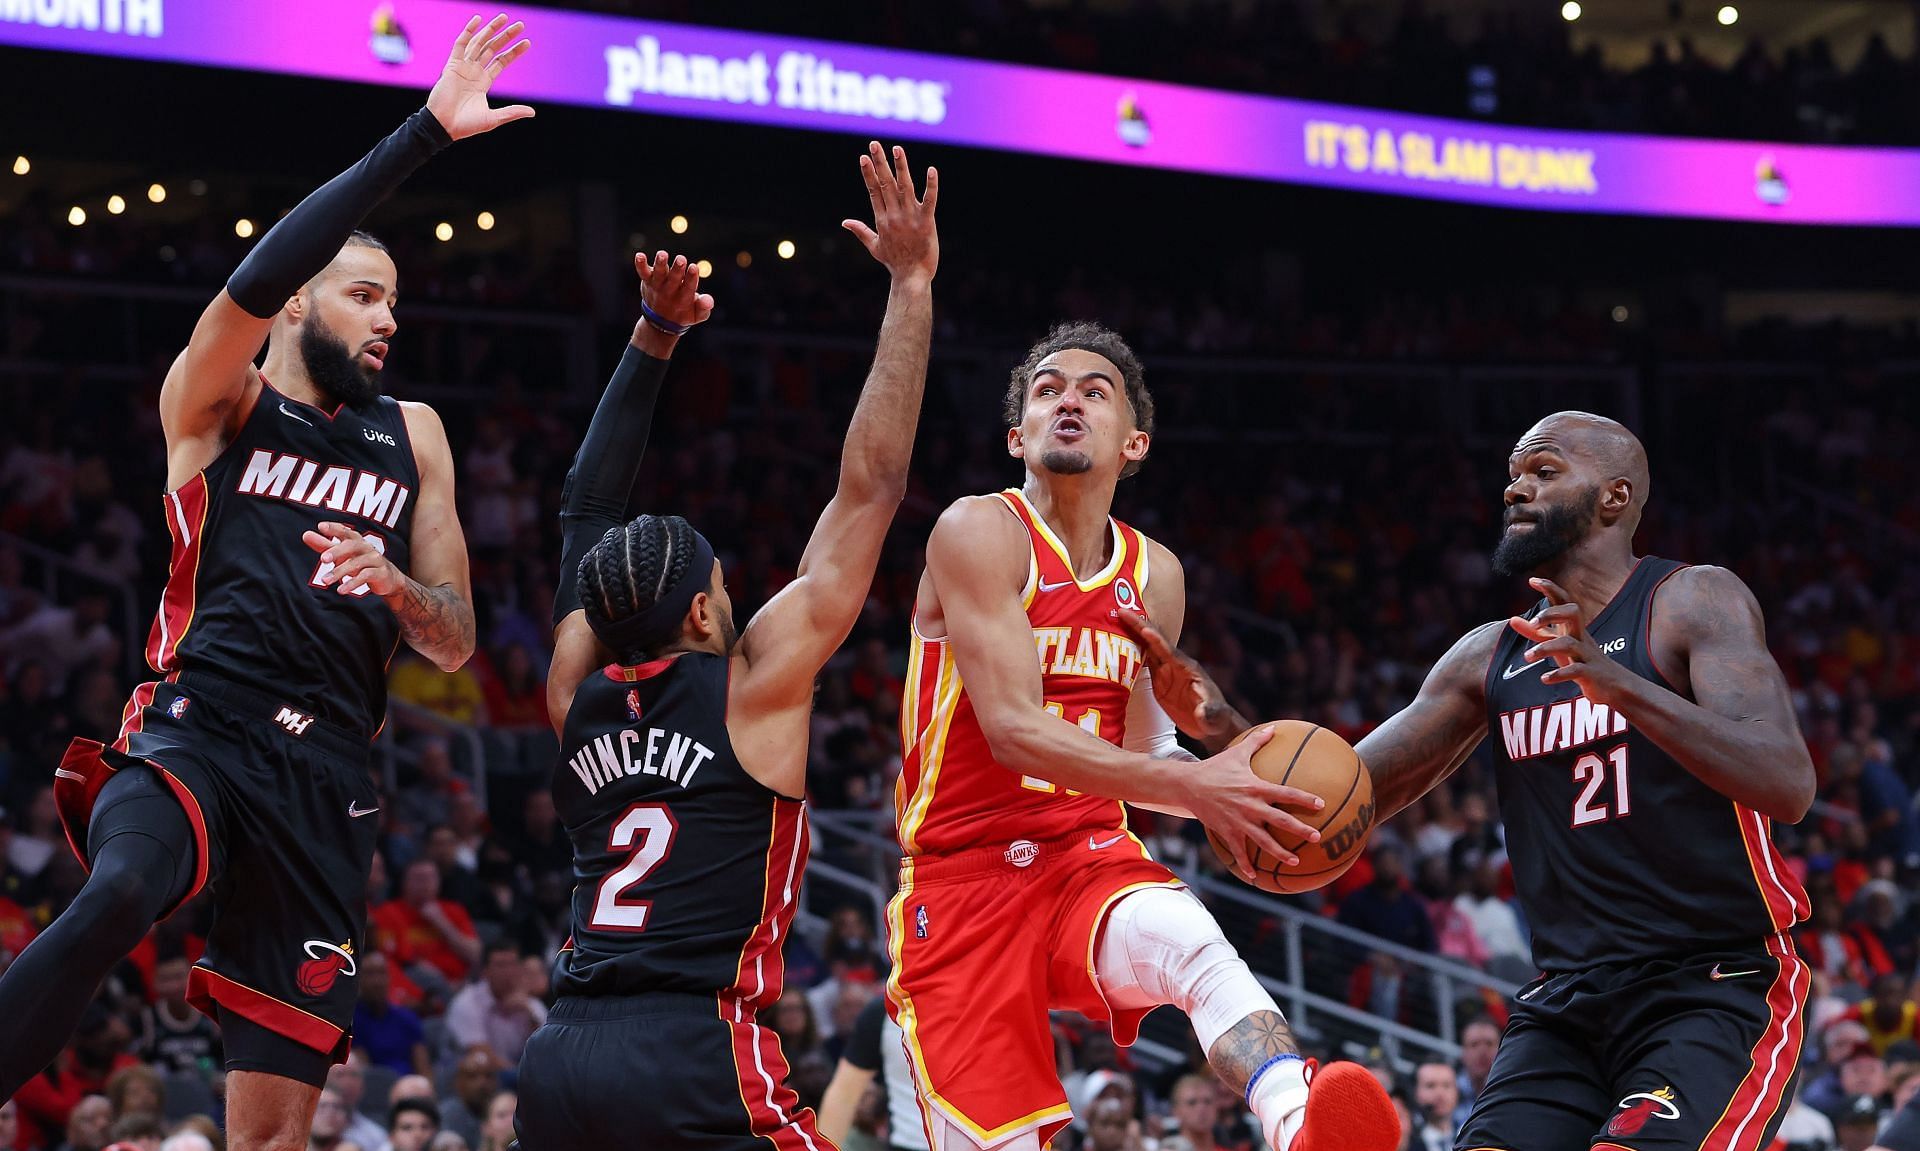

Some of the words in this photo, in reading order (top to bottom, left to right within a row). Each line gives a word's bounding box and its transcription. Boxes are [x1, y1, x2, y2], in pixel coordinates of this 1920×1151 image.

[605, 35, 771, 105] planet
[774, 51, 946, 123] fitness
[1304, 120, 1370, 171] IT'S
[1372, 130, 1399, 174] A
[1400, 132, 1492, 186] SLAM
[1495, 142, 1597, 194] DUNK
[236, 448, 409, 529] MIAMI
[1032, 627, 1142, 690] TLANT
[1599, 637, 1626, 655] KG
[568, 727, 715, 796] VINCENT
[1571, 743, 1630, 828] 21
[588, 803, 678, 931] 2
[1004, 844, 1039, 862] HAWKS
